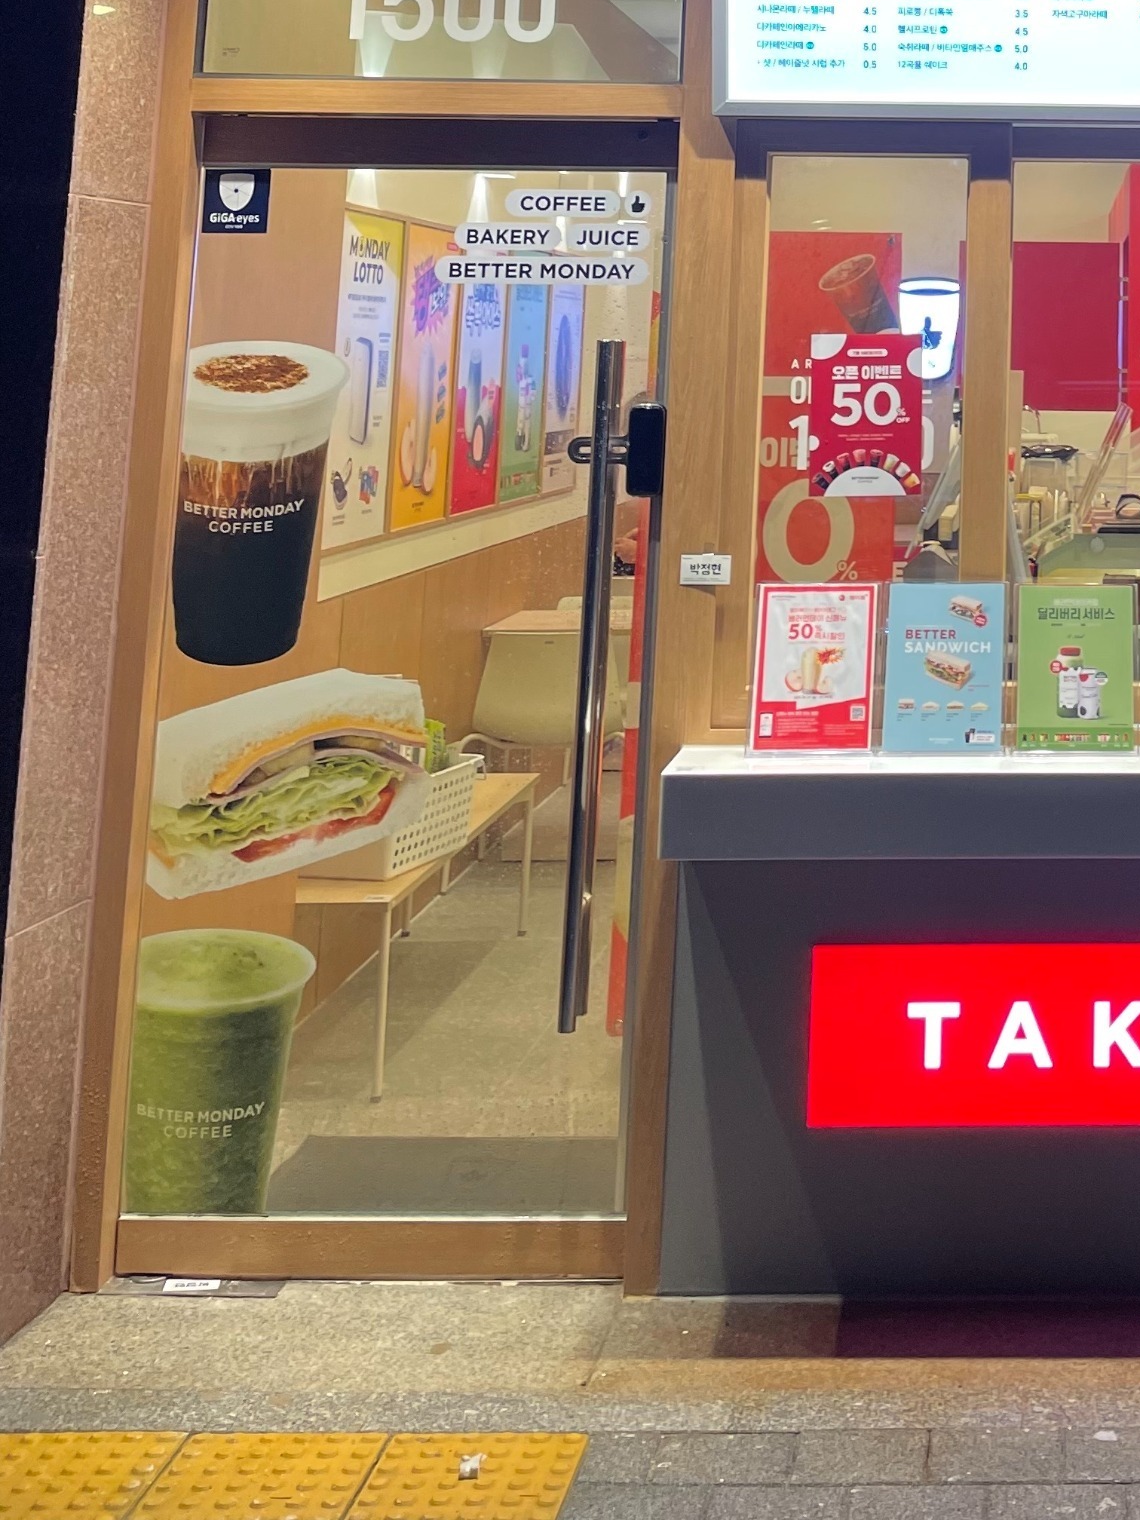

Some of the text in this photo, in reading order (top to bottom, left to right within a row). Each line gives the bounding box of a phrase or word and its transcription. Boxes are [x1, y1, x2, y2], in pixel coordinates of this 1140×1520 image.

[863, 7, 877, 15] 4.5
[863, 43, 876, 51] 5.0
[1015, 45, 1028, 53] 5.0
[863, 60, 876, 68] 0.5
[1015, 62, 1027, 70] 4.0
[519, 195, 607, 213] COFFEE
[465, 228, 640, 246] BAKERY JUICE
[353, 261, 384, 286] LOTTO
[448, 262, 636, 281] BETTER MONDAY
[831, 365, 903, 381] 오픈 이벤트
[830, 382, 902, 427] 50
[183, 497, 305, 520] BETTER MONDAY
[208, 519, 274, 535] COFFEE
[689, 563, 722, 576] 박정현
[1037, 607, 1116, 621] 딜리버리 서비스
[788, 623, 814, 640] 50
[905, 629, 957, 640] BETTER
[904, 641, 991, 654] SANDWICH
[136, 1100, 266, 1124] BETTER MONDAY
[163, 1124, 233, 1140] COFFEE
